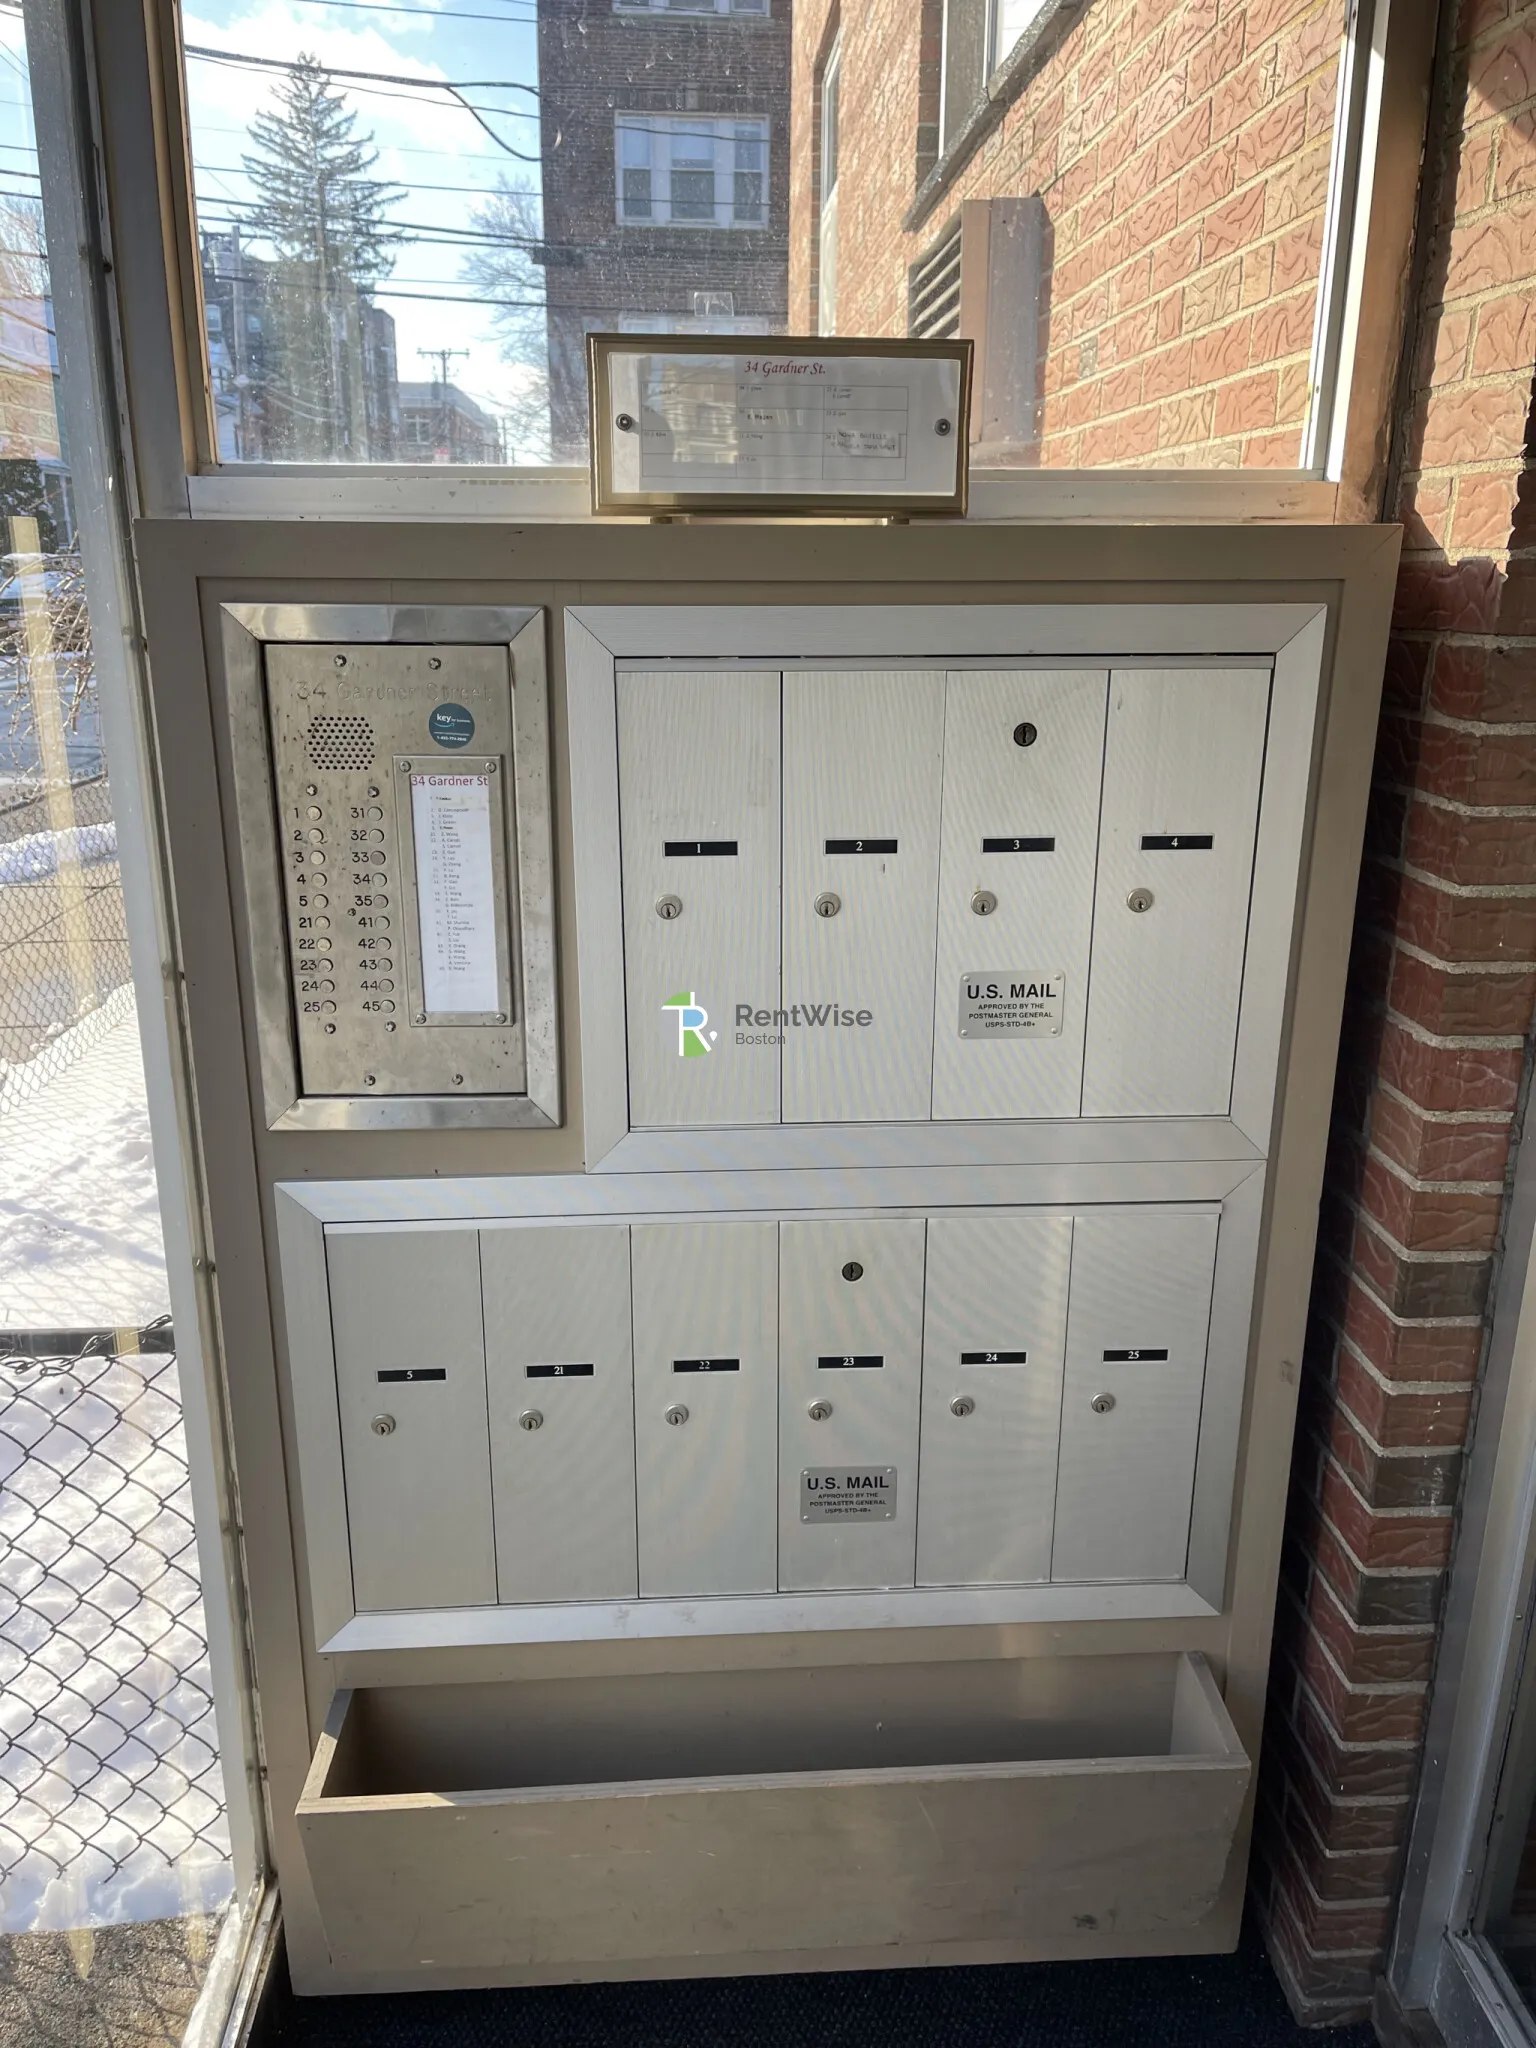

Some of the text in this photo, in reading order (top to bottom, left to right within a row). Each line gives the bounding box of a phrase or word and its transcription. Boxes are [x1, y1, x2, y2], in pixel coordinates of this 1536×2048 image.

[744, 360, 826, 378] 34 Gardner St.
[296, 681, 327, 700] 34
[337, 682, 415, 700] Gardner
[436, 713, 452, 723] key
[411, 776, 488, 787] 34 Gardner St
[294, 807, 299, 819] 1
[350, 807, 365, 819] 31
[294, 829, 302, 841] 2
[350, 829, 368, 841] 32
[855, 841, 863, 852] 2
[1012, 839, 1020, 850] 3
[1170, 837, 1179, 848] 4
[296, 851, 304, 863] 3
[352, 851, 370, 863] 33
[296, 873, 306, 885] 4
[353, 873, 371, 885] 34
[299, 895, 308, 907] 5
[354, 895, 373, 907] 35
[298, 917, 312, 928] 21
[358, 917, 373, 928] 41
[298, 938, 315, 950] 22
[358, 938, 376, 950] 42
[300, 960, 317, 971] 23
[359, 960, 377, 971] 43
[301, 981, 319, 992] 24
[360, 980, 378, 991] 44
[967, 983, 1057, 999] U.S. MAIL
[303, 1001, 321, 1013] 25
[362, 1001, 381, 1012] 45
[985, 1353, 998, 1362] 24
[1127, 1350, 1140, 1360] 25
[842, 1357, 855, 1366] 23
[406, 1370, 413, 1380] 5
[553, 1366, 564, 1375] 21
[807, 1476, 889, 1490] U.S. MAIL
